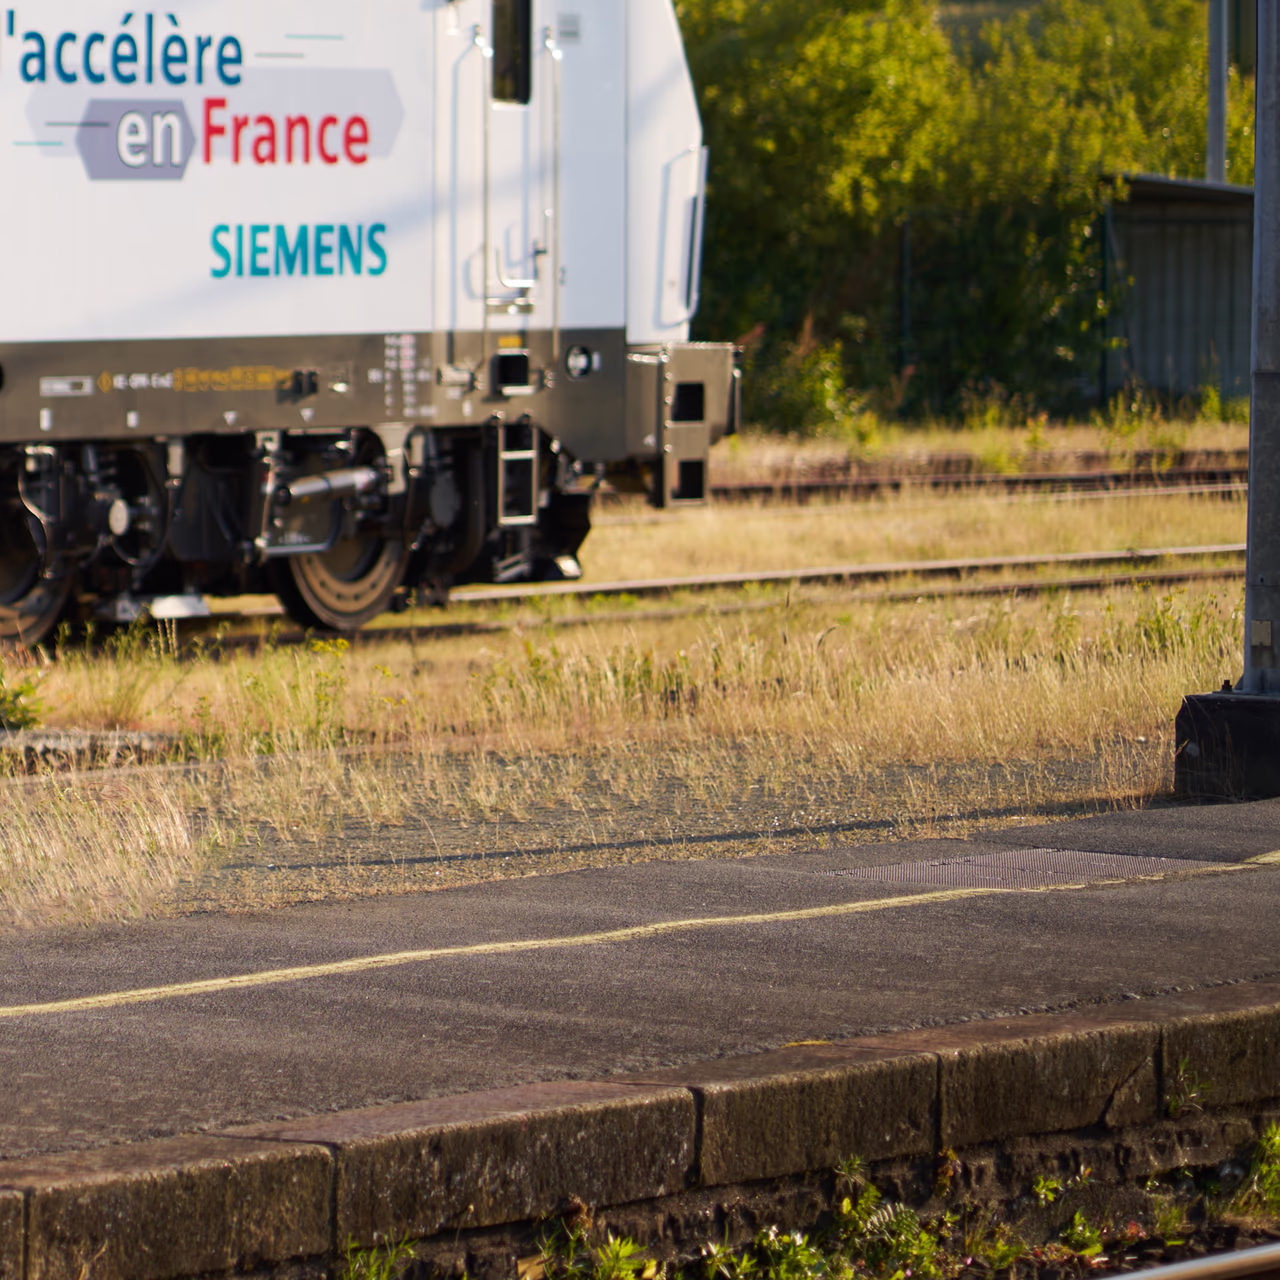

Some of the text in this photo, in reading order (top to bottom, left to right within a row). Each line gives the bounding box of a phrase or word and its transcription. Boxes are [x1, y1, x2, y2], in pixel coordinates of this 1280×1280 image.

[116, 97, 370, 168] en France
[209, 223, 388, 279] SIEMENS
